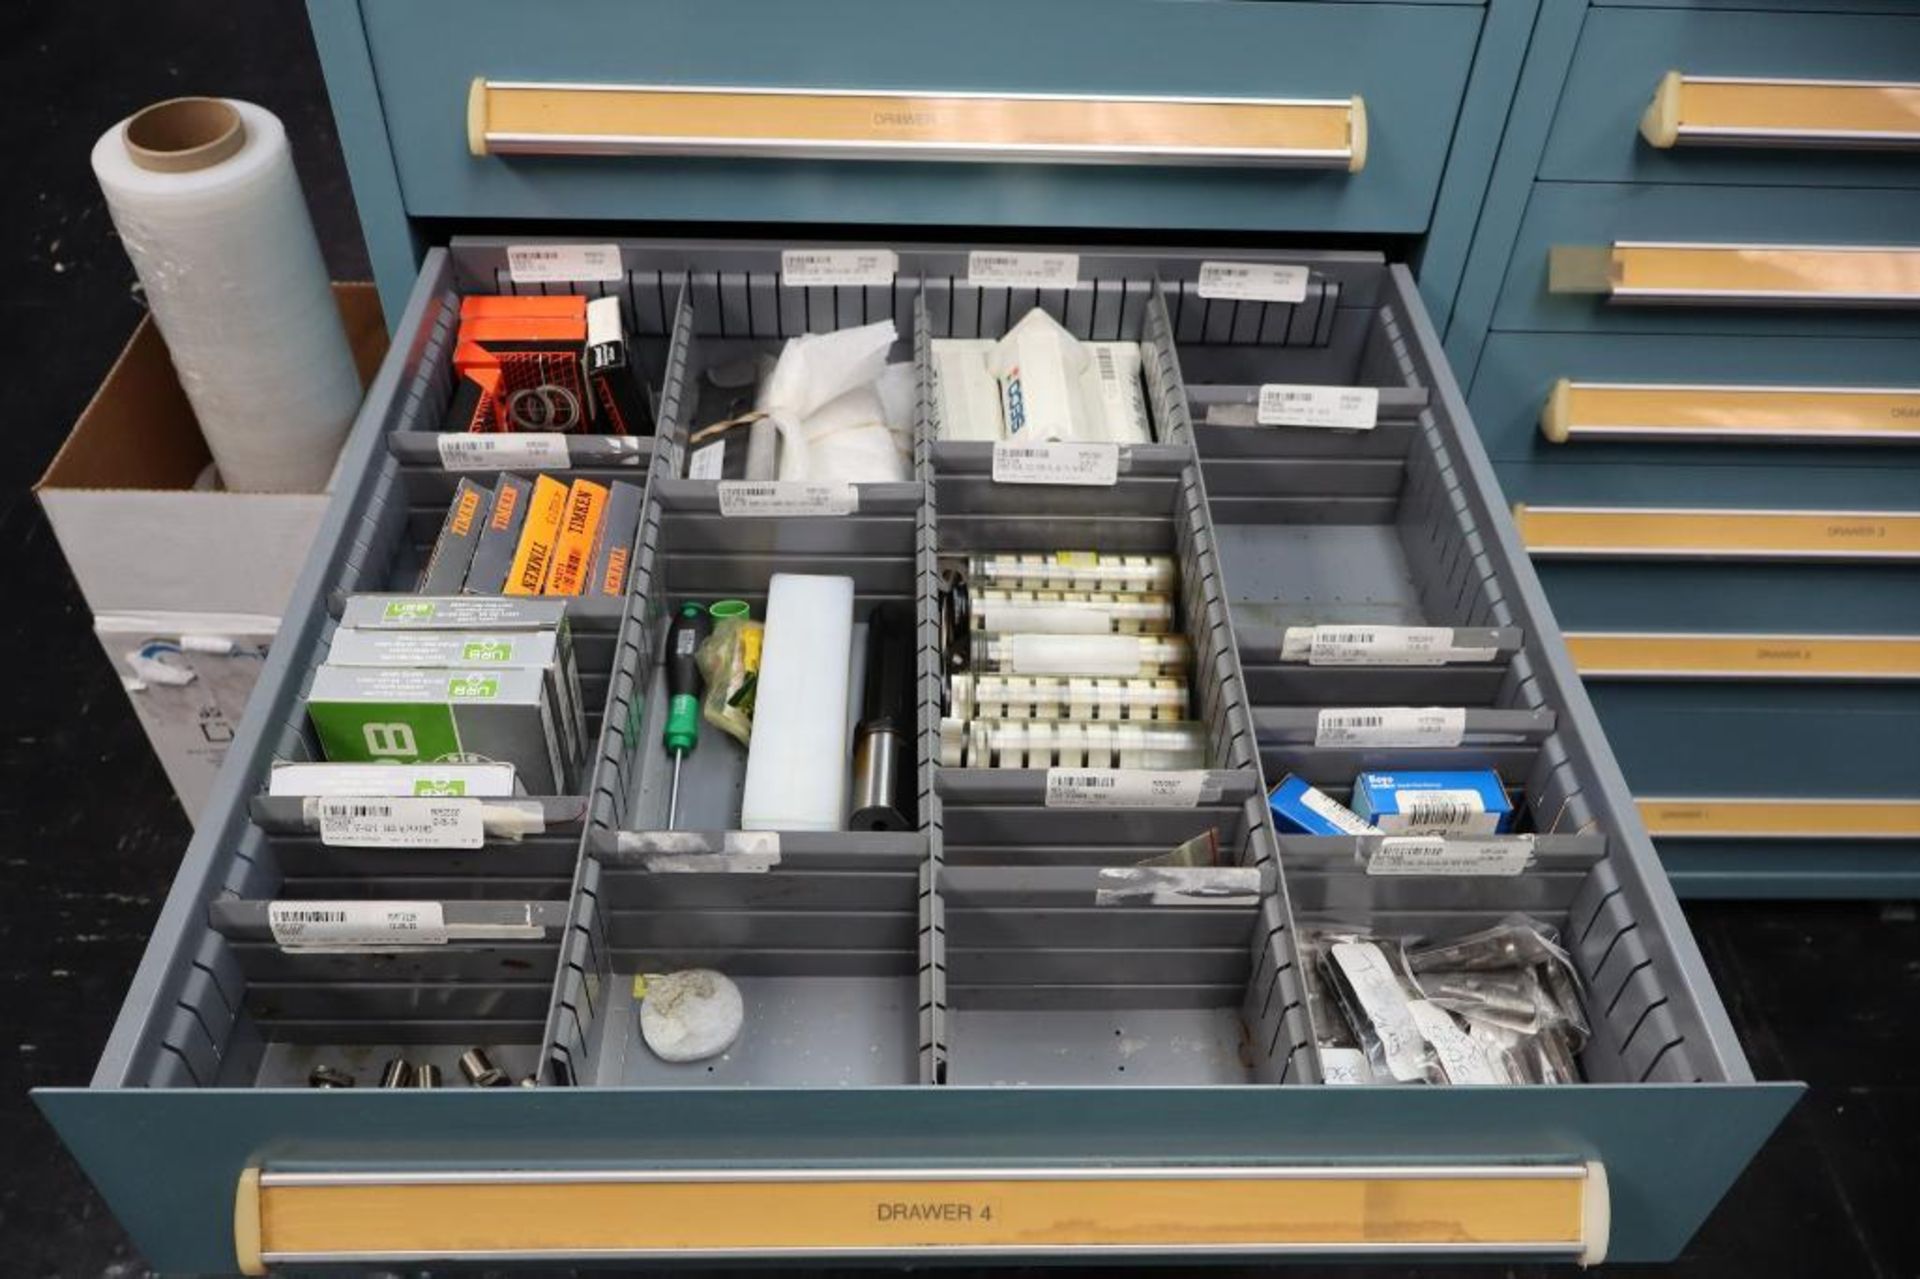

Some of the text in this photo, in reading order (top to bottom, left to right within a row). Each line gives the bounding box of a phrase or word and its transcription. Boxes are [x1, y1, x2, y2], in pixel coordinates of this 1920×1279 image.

[567, 490, 592, 534] TIMKEN
[1827, 526, 1876, 537] DRAWER
[520, 541, 548, 594] TIMKEN
[877, 1202, 992, 1221] DRAWER 4
